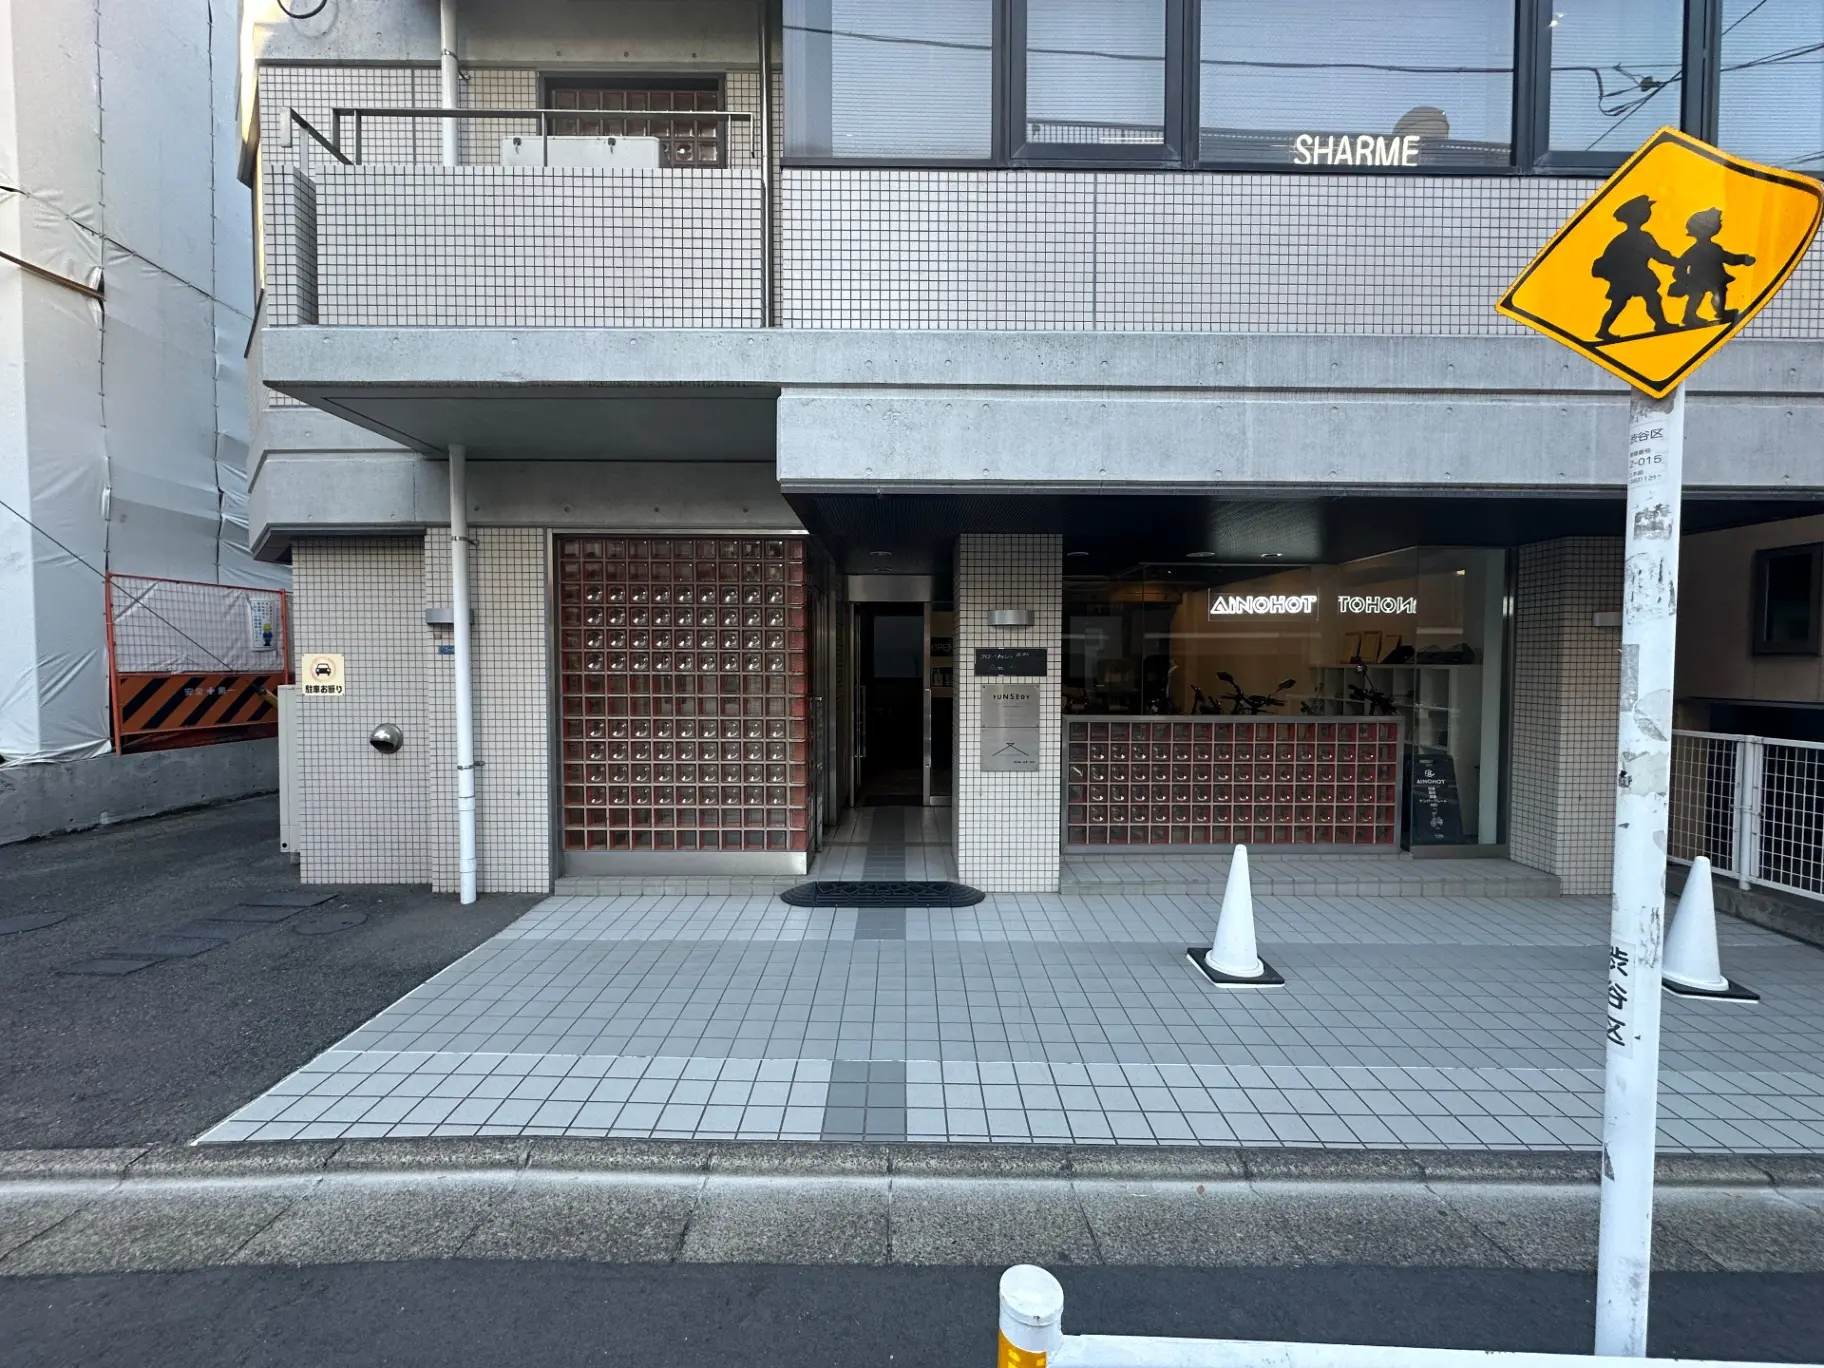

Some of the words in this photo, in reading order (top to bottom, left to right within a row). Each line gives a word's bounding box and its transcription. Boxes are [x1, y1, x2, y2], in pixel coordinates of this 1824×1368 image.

[1293, 134, 1420, 166] SHARME
[1210, 595, 1318, 614] AINOHOT
[305, 685, 343, 693] 駐車お断り
